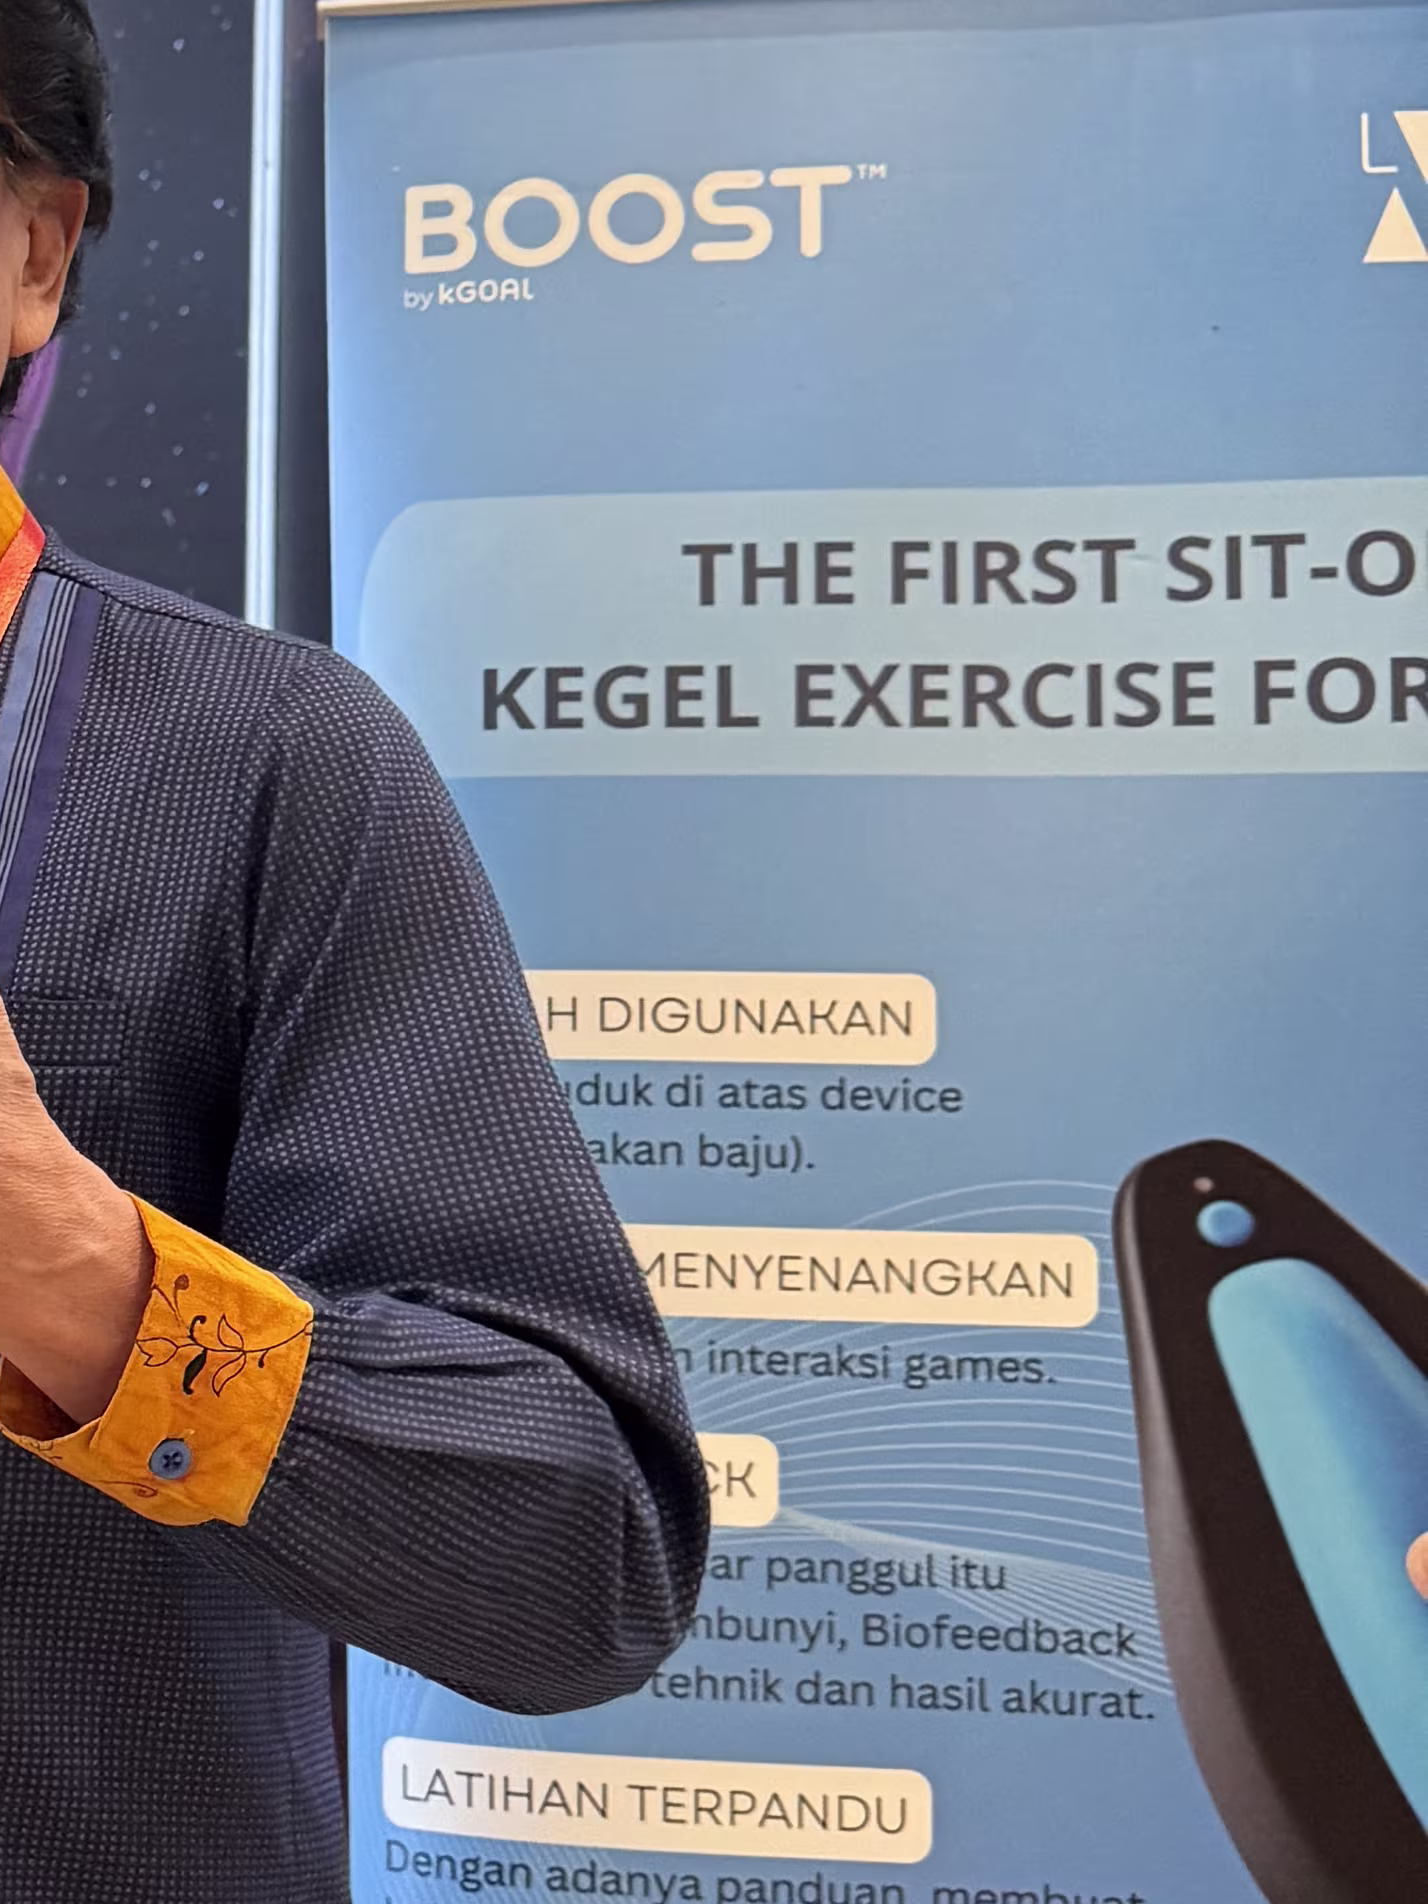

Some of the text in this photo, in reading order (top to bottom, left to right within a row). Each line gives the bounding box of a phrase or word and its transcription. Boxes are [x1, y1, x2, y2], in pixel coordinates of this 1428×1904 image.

[404, 164, 853, 274] BOOST
[404, 277, 535, 311] by kGOAL
[682, 530, 1428, 607] THE FIRST SIT-O
[482, 656, 1428, 732] KEGEL EXERCISE FOR
[598, 995, 913, 1037] DIGUNAKAN
[666, 1073, 705, 1108] di
[717, 1079, 808, 1111] atas
[820, 1075, 965, 1114] device
[697, 1133, 816, 1176] baju).
[707, 1339, 891, 1380] interaksi
[902, 1353, 1057, 1390] games.
[766, 1553, 938, 1596] panggul
[950, 1555, 1007, 1592] itu
[861, 1612, 1139, 1659] Biofeedback
[650, 1666, 1157, 1721] tehnik dan hasil akurat.
[402, 1763, 908, 1836] LATIHAN TERPANDU
[385, 1838, 533, 1894] Dengan
